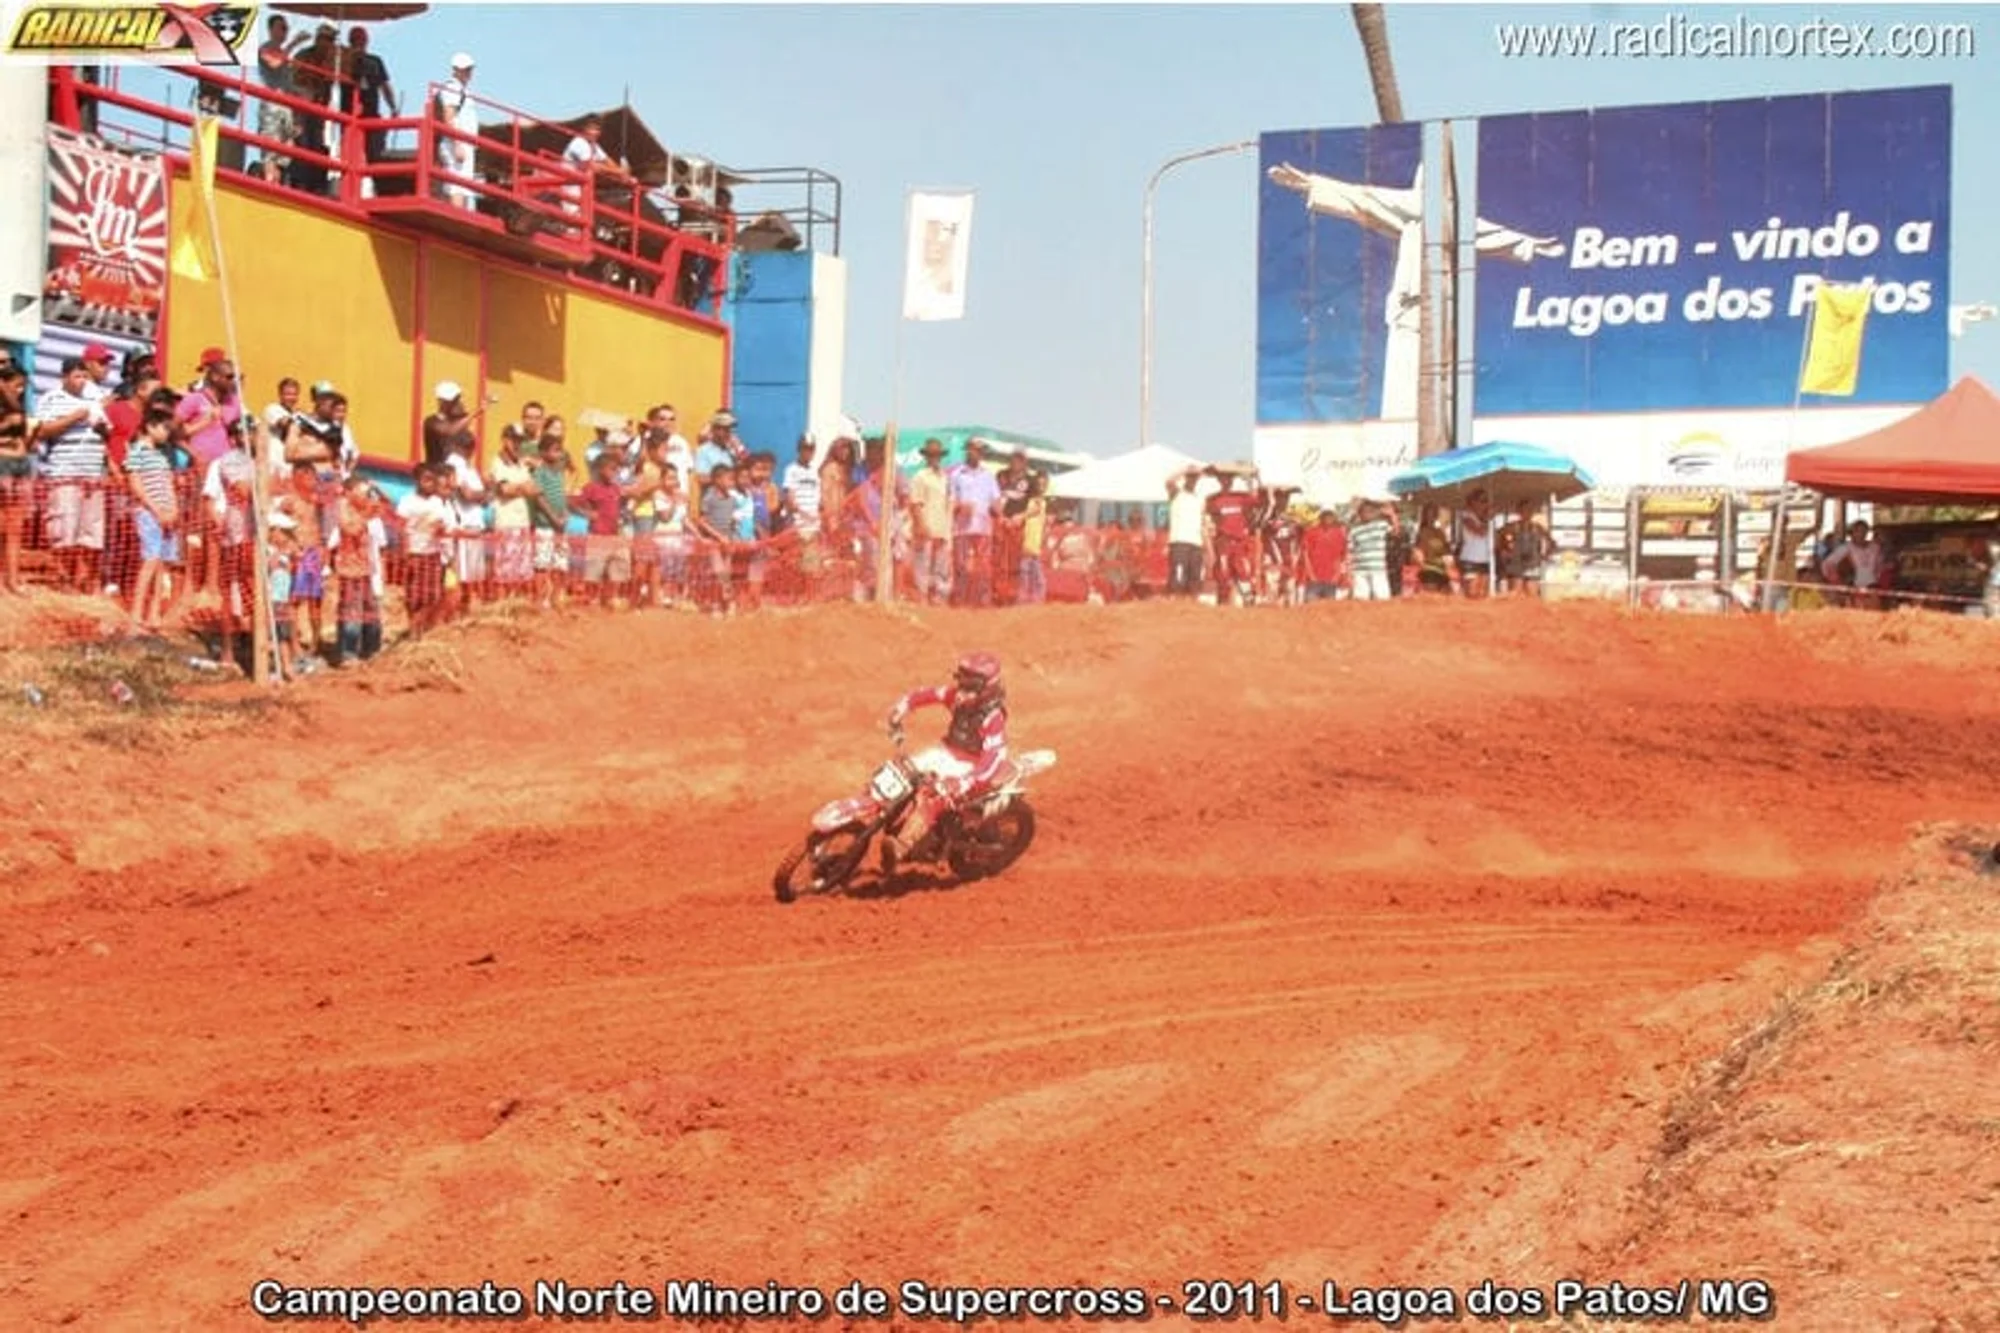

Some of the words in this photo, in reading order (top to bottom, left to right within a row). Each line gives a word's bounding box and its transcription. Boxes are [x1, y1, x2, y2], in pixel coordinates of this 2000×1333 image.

[1570, 227, 1679, 269] Bem
[1732, 211, 1880, 261] vindo
[1895, 221, 1932, 254] a
[1513, 287, 1668, 337] Lagoa
[1683, 276, 1773, 322] dos
[1788, 272, 1933, 317] Pos
